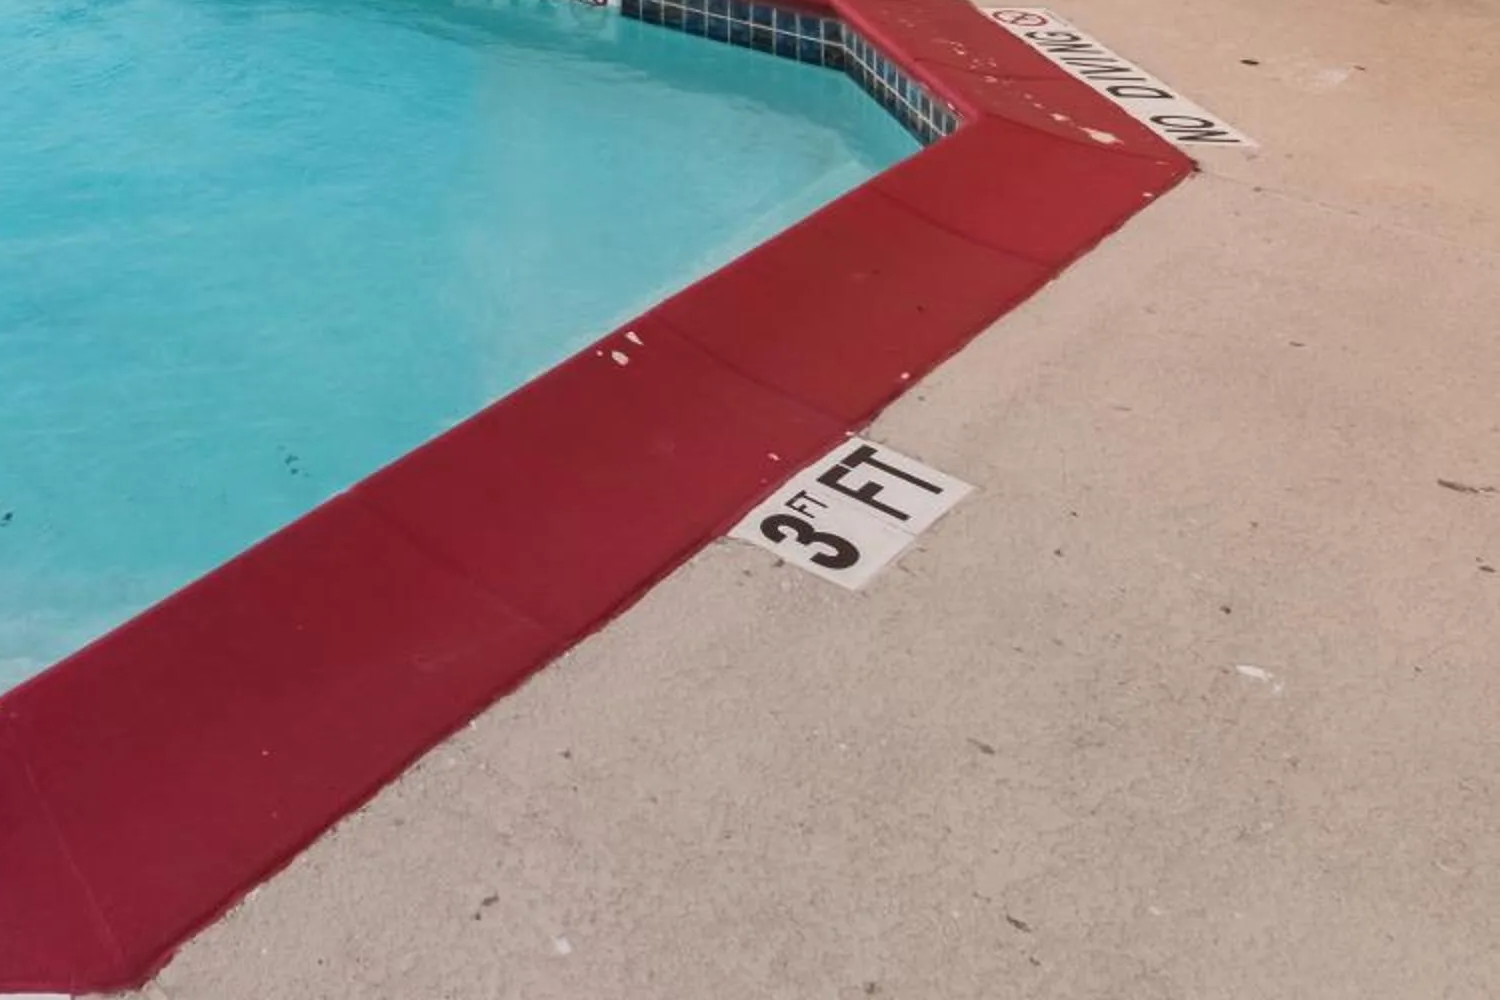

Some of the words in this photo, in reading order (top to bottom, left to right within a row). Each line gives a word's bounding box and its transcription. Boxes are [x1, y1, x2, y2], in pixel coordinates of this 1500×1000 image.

[1024, 30, 1174, 99] DIVING
[1149, 114, 1240, 143] NO
[784, 489, 829, 519] FT
[816, 444, 944, 521] FT
[760, 513, 860, 569] 3
